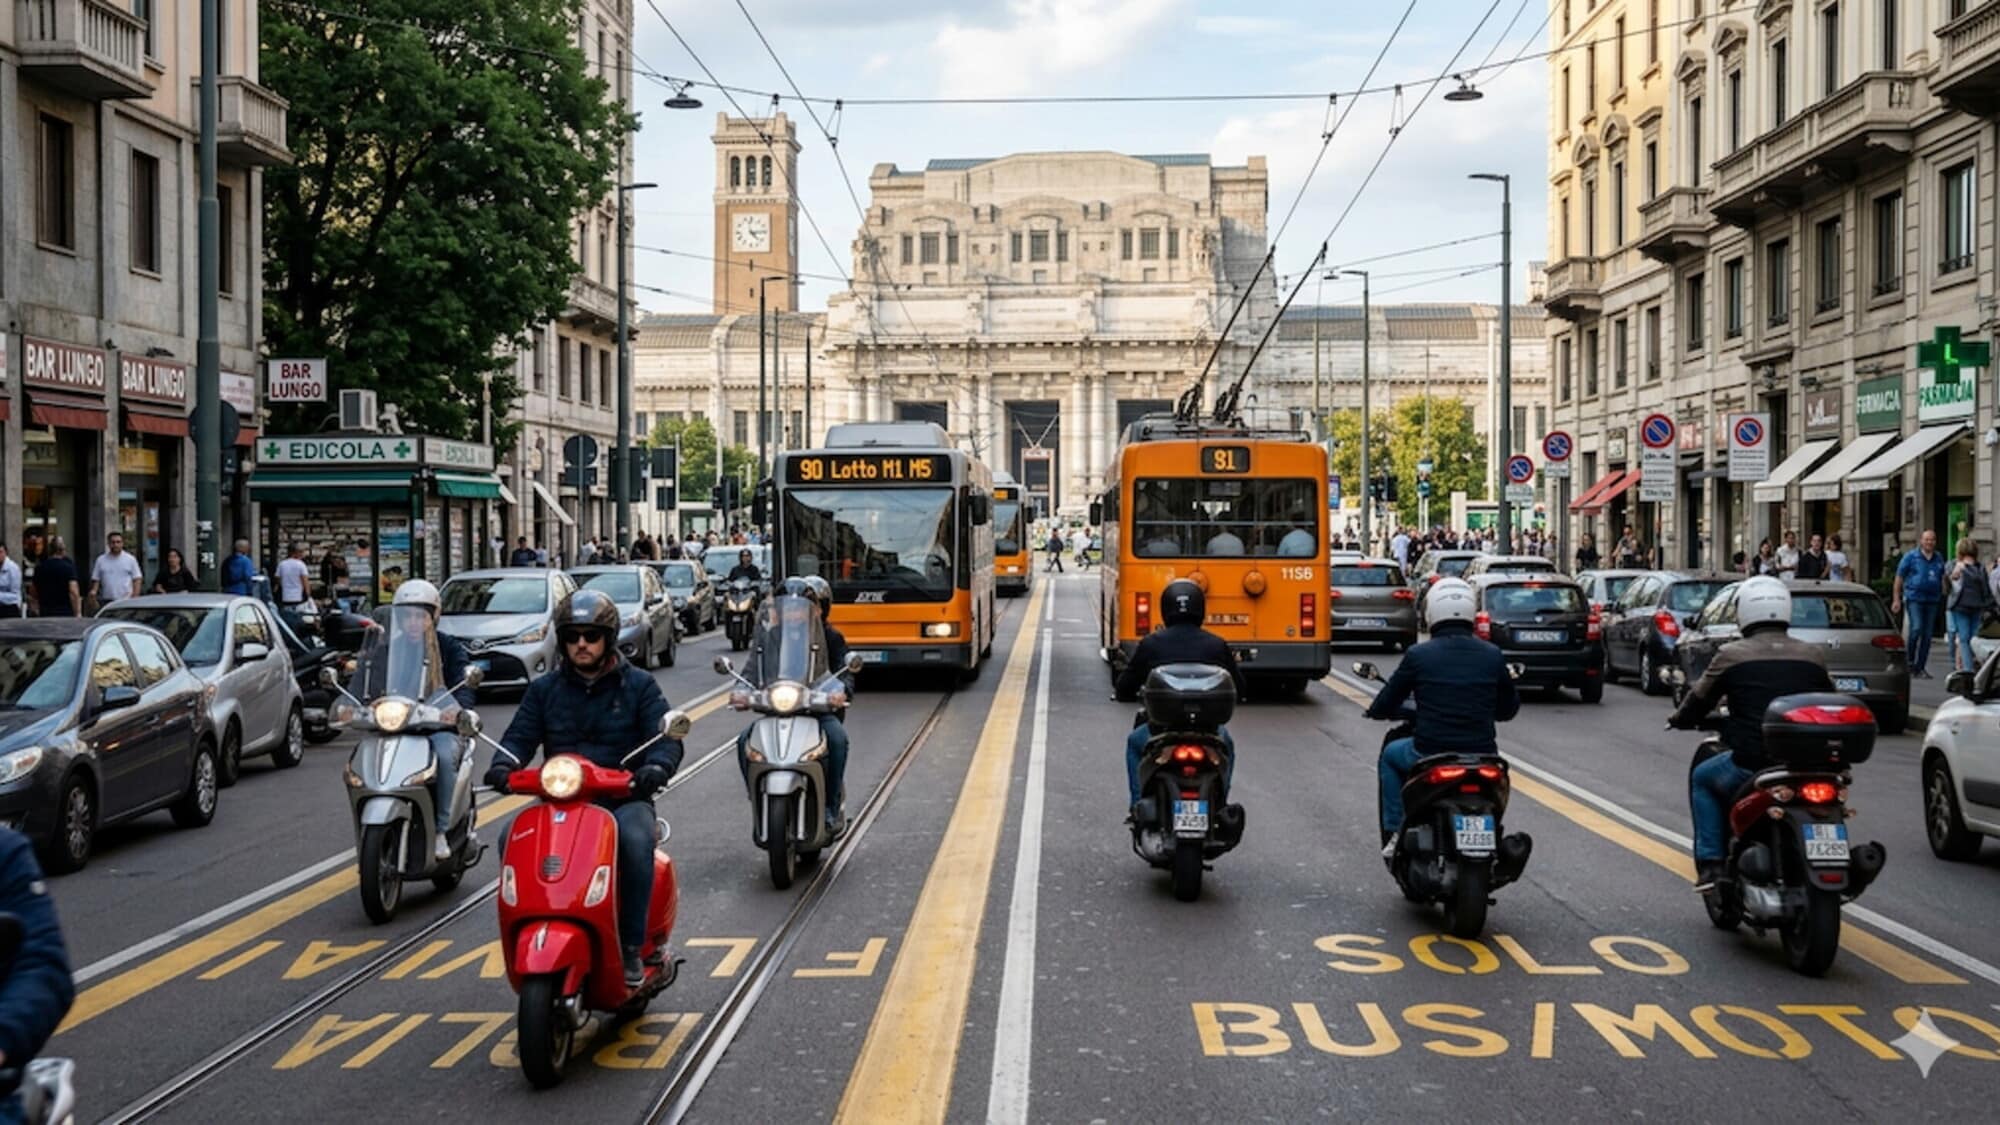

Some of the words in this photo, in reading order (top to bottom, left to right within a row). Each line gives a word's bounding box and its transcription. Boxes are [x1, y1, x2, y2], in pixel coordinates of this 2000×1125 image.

[26, 344, 56, 380] BAR
[59, 349, 105, 387] LUNGO
[281, 363, 311, 379] BAR
[122, 360, 146, 393] BAR
[148, 366, 185, 399] LUNGO
[271, 382, 321, 398] LUNGO
[289, 442, 386, 459] EDICOLA
[800, 459, 823, 480] 90
[831, 460, 877, 479] Lotto
[882, 459, 903, 478] M1
[909, 458, 932, 477] M5
[1314, 934, 1690, 976] SOLO
